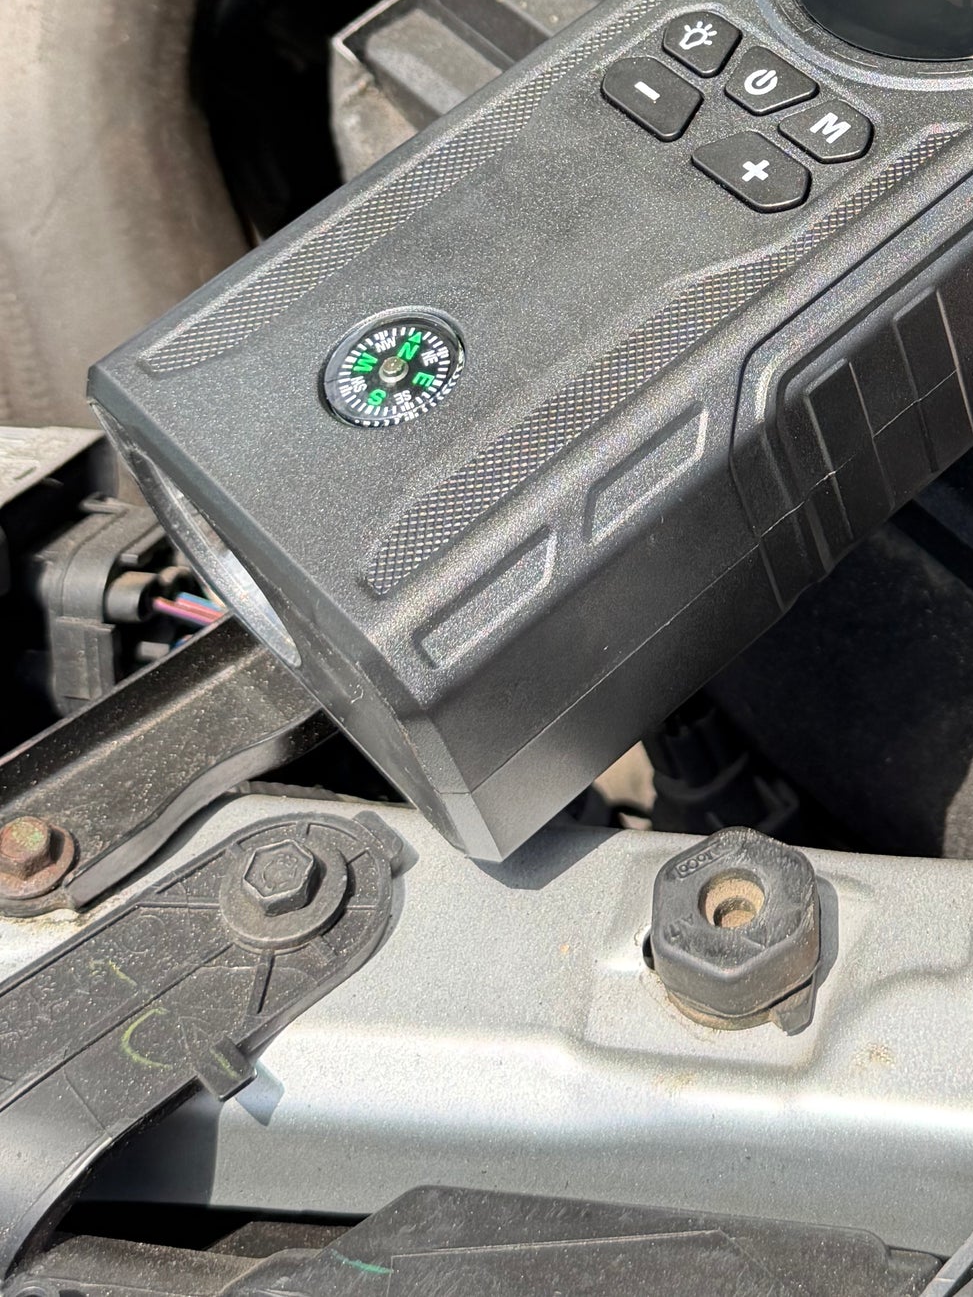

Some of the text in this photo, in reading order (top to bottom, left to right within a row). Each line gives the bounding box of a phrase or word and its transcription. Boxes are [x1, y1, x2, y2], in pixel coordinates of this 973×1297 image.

[809, 112, 851, 144] M
[375, 337, 397, 353] NW
[397, 342, 420, 360] N
[353, 352, 378, 372] W
[421, 350, 438, 367] NE
[351, 376, 368, 393] SW
[412, 371, 435, 387] E
[368, 389, 386, 406] S
[393, 390, 412, 405] SE
